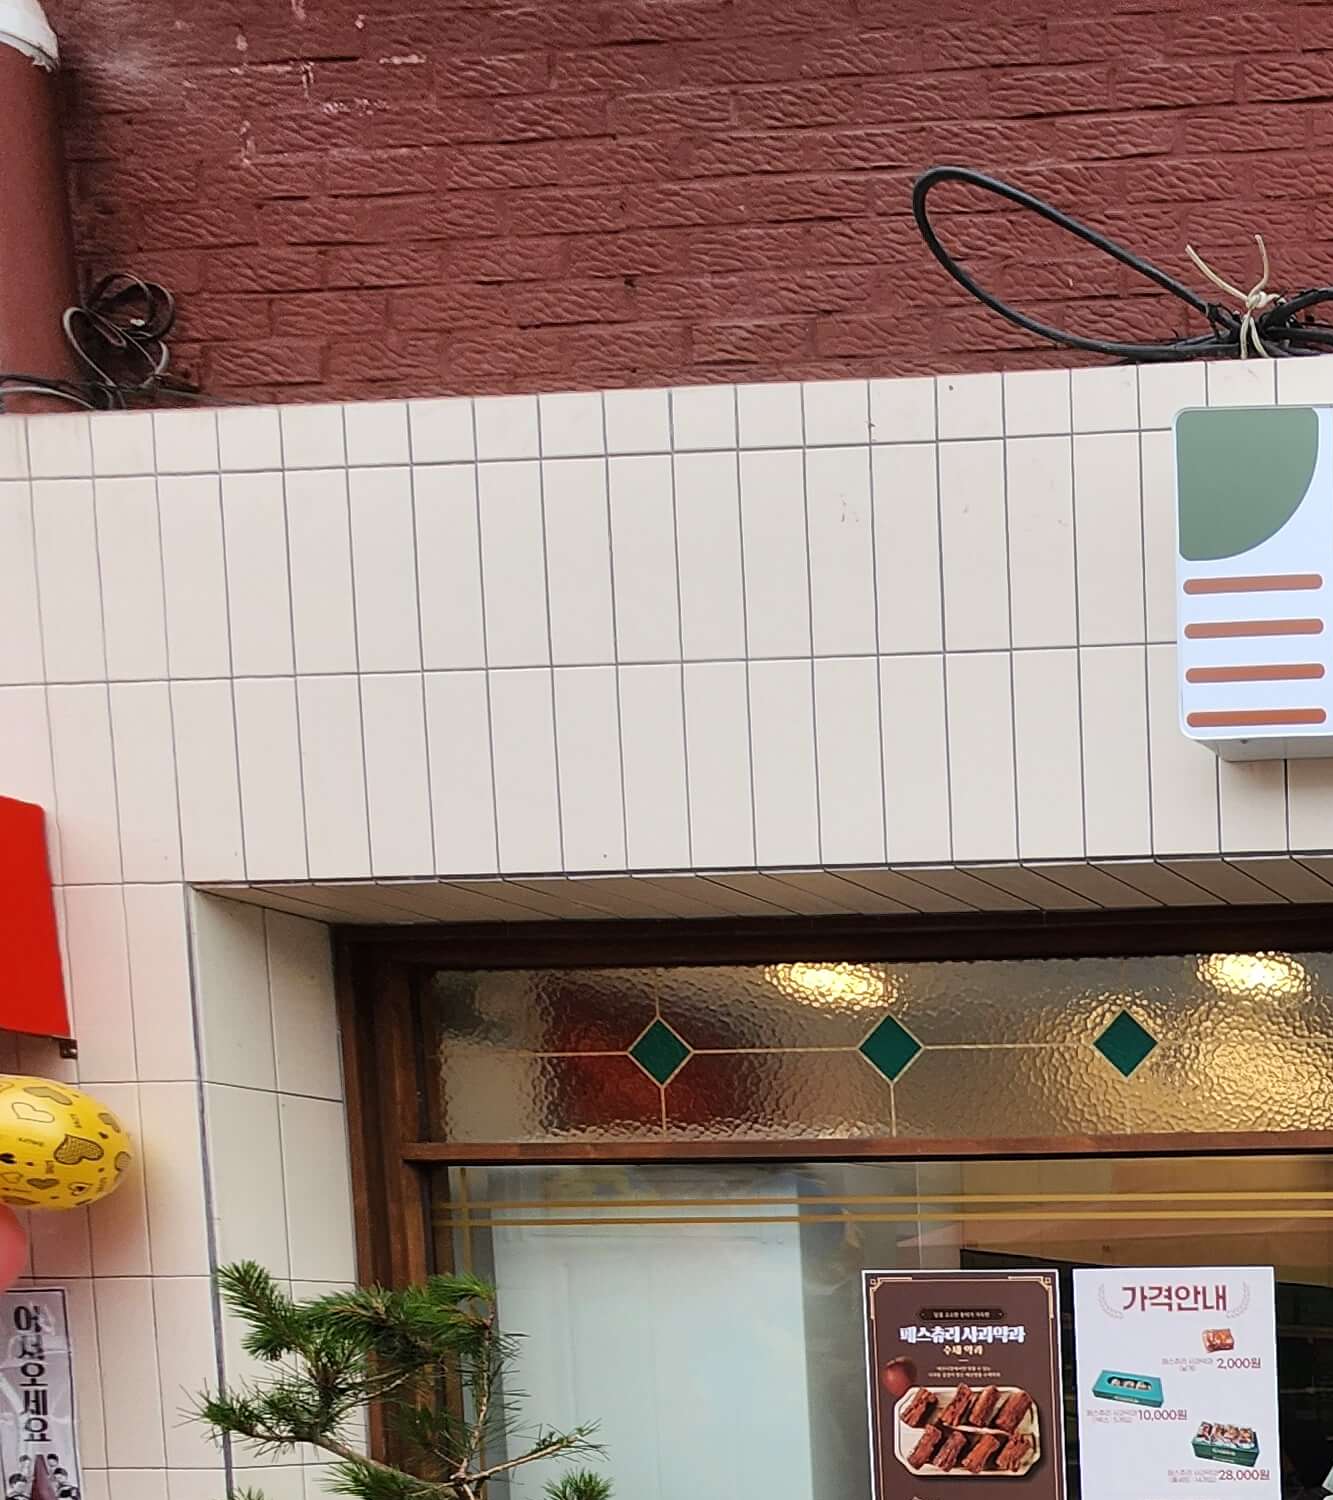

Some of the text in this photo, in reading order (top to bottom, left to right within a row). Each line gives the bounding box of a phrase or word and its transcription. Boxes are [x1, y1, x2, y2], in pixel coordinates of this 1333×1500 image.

[1121, 1285, 1227, 1312] 가격안내
[961, 1325, 1027, 1344] 사과약과
[1216, 1357, 1262, 1370] 2,000원
[1138, 1409, 1188, 1422] 10,000원
[1218, 1469, 1270, 1481] 28,000원
